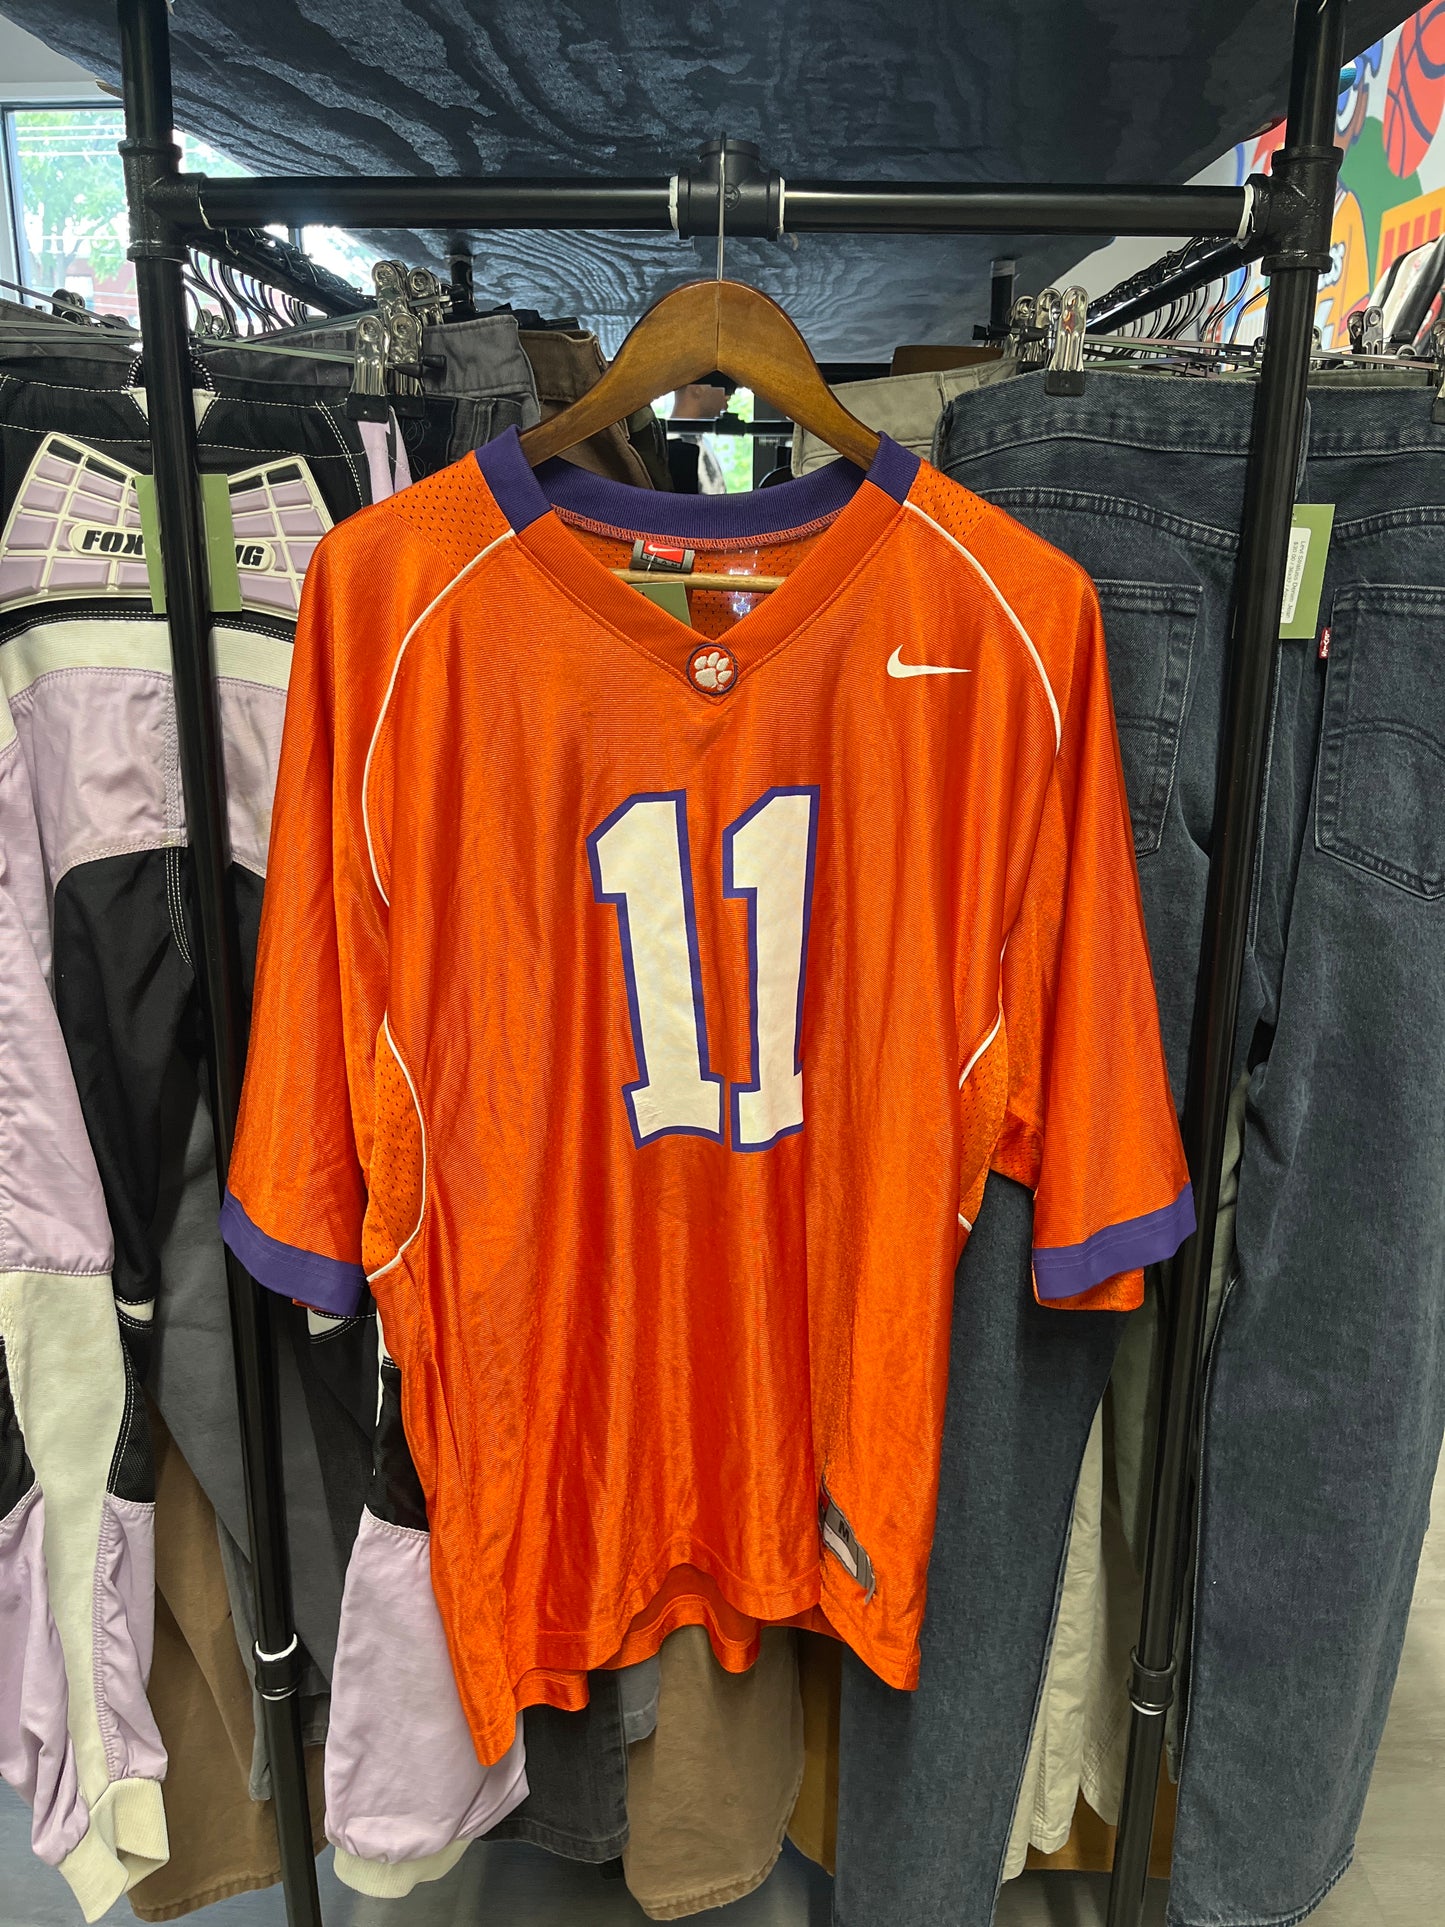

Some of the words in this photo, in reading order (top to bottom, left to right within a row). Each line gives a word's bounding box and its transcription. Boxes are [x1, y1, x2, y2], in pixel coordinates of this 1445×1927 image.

[82, 529, 143, 555] FOX
[586, 785, 820, 1152] 11
[839, 1520, 850, 1542] M
